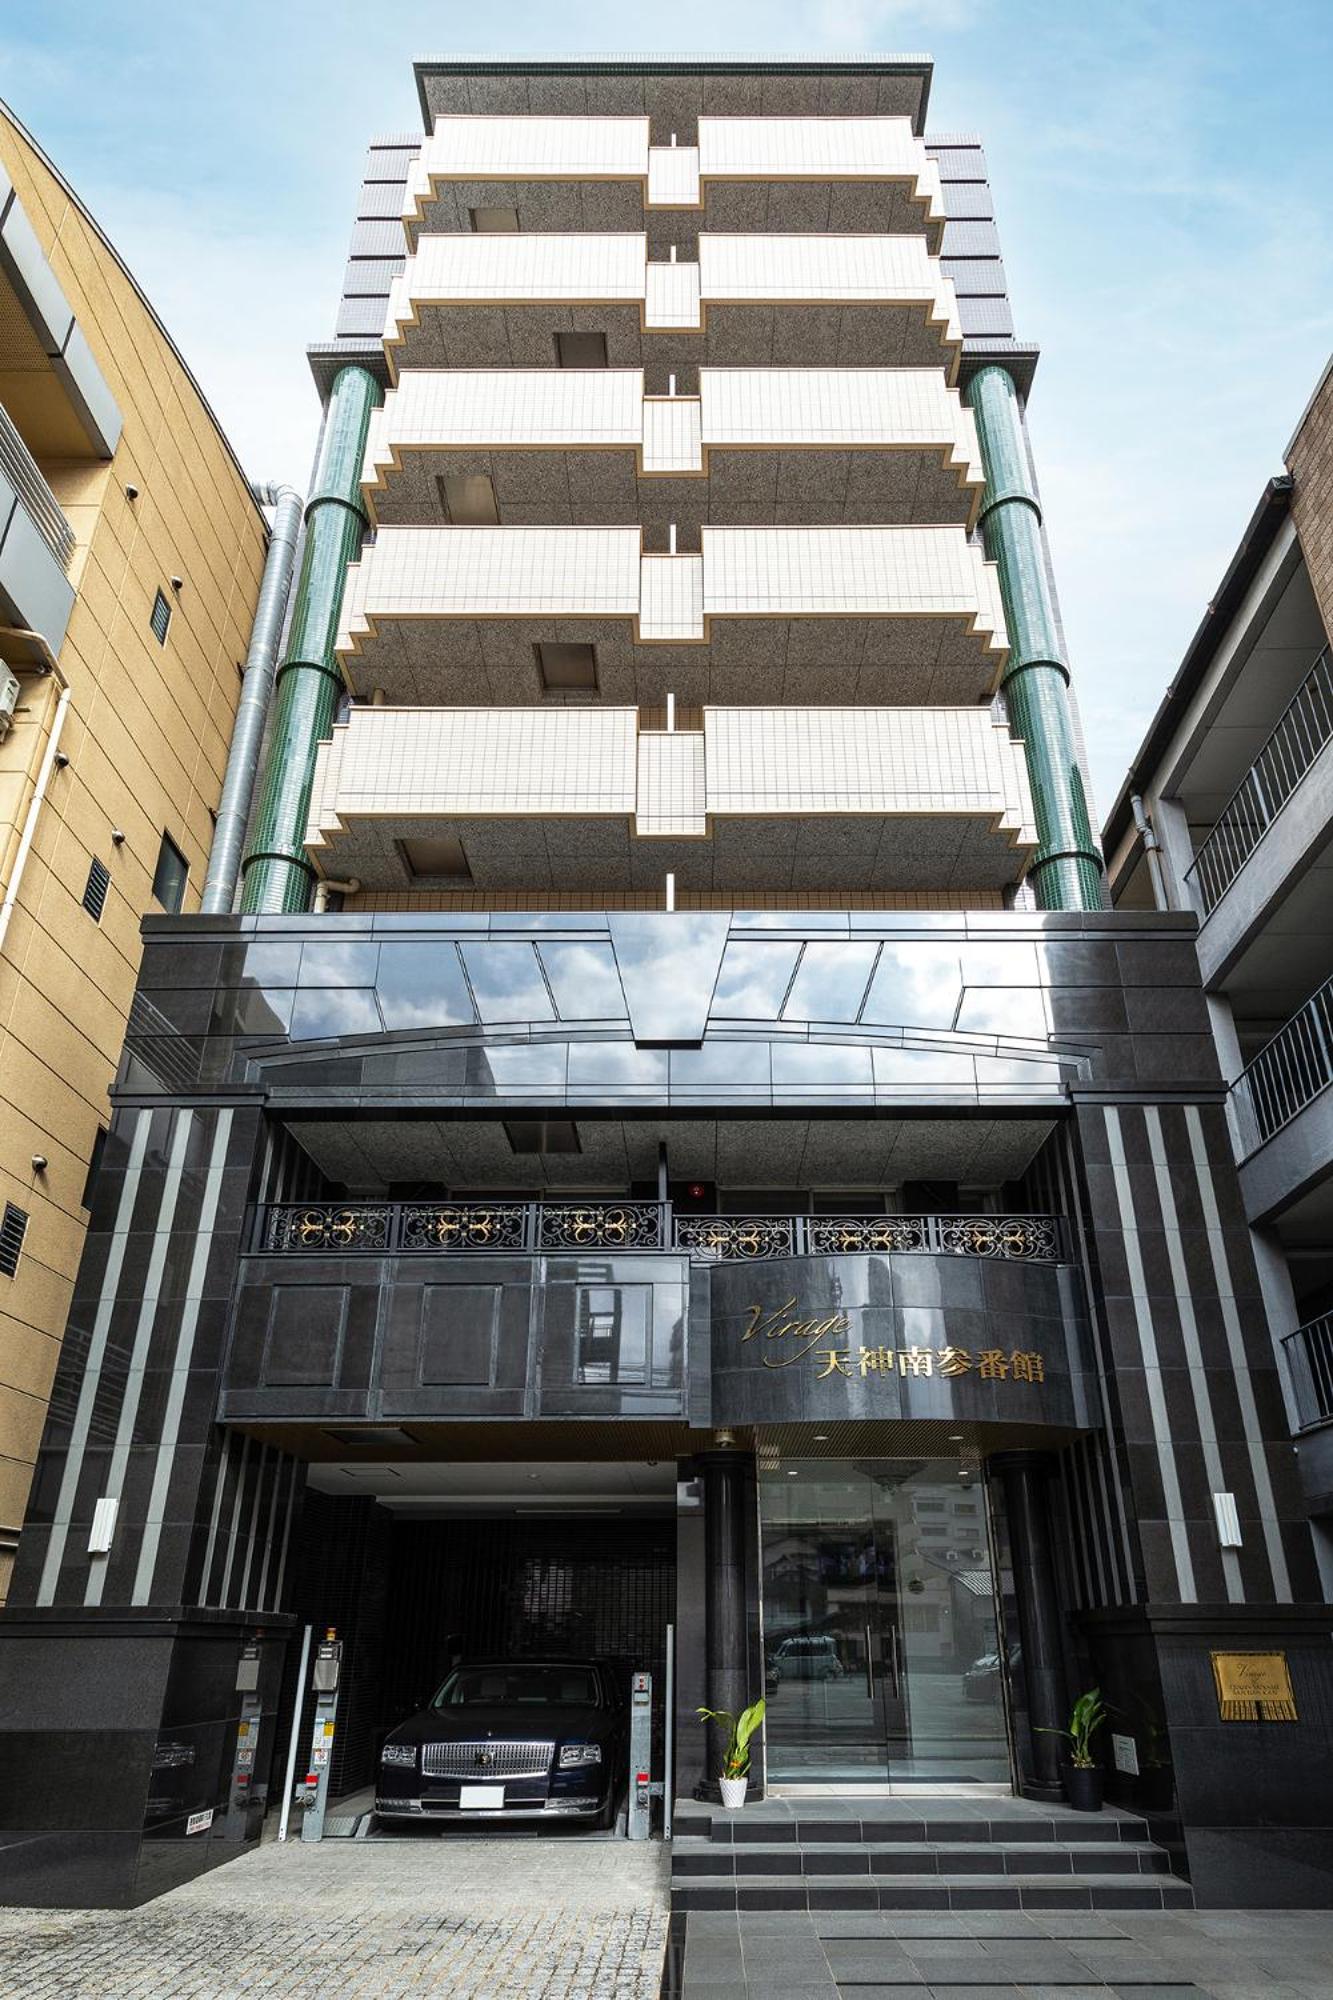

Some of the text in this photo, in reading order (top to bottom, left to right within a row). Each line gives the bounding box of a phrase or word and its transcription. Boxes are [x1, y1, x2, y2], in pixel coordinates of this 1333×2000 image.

[741, 1297, 853, 1368] Virage
[815, 1346, 1044, 1383] 天神南参番館
